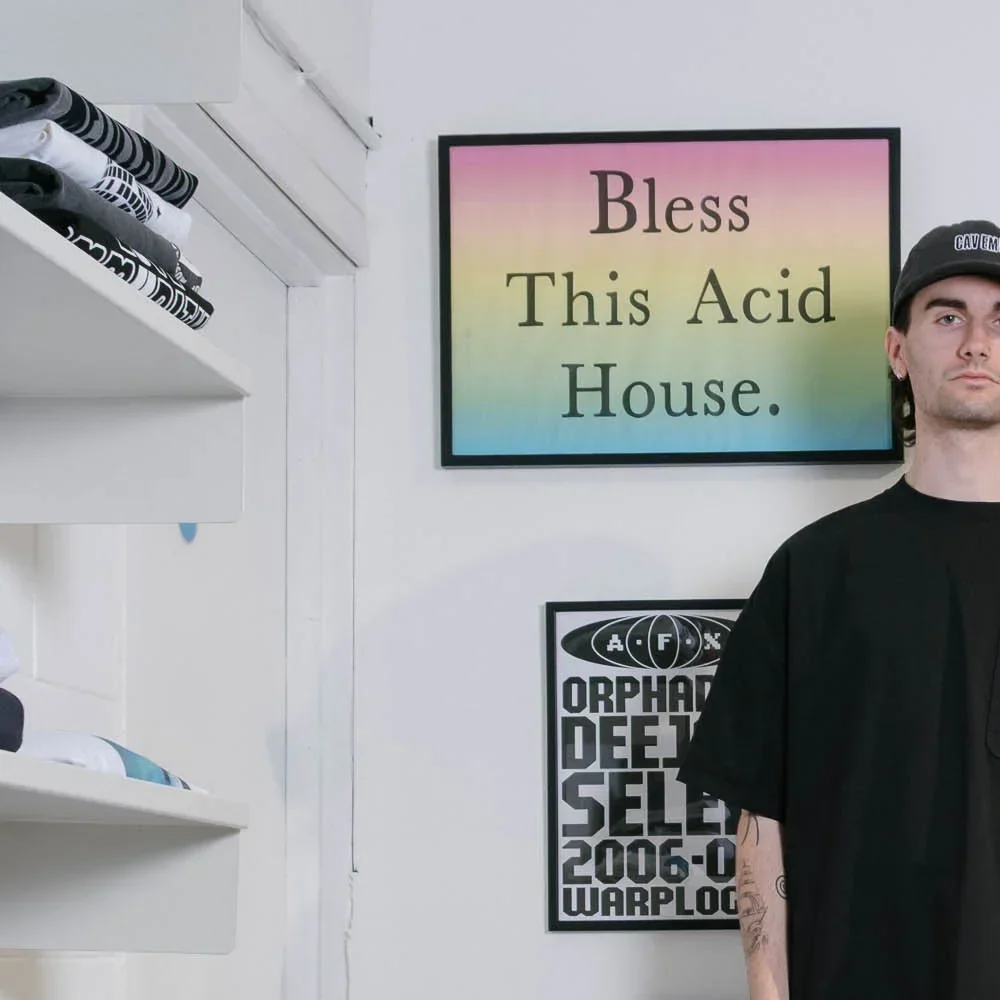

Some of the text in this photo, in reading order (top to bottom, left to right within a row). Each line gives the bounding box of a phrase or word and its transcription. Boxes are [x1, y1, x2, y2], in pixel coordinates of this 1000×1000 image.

[590, 169, 750, 234] Bless
[506, 265, 836, 327] This Acid
[561, 362, 780, 419] House.
